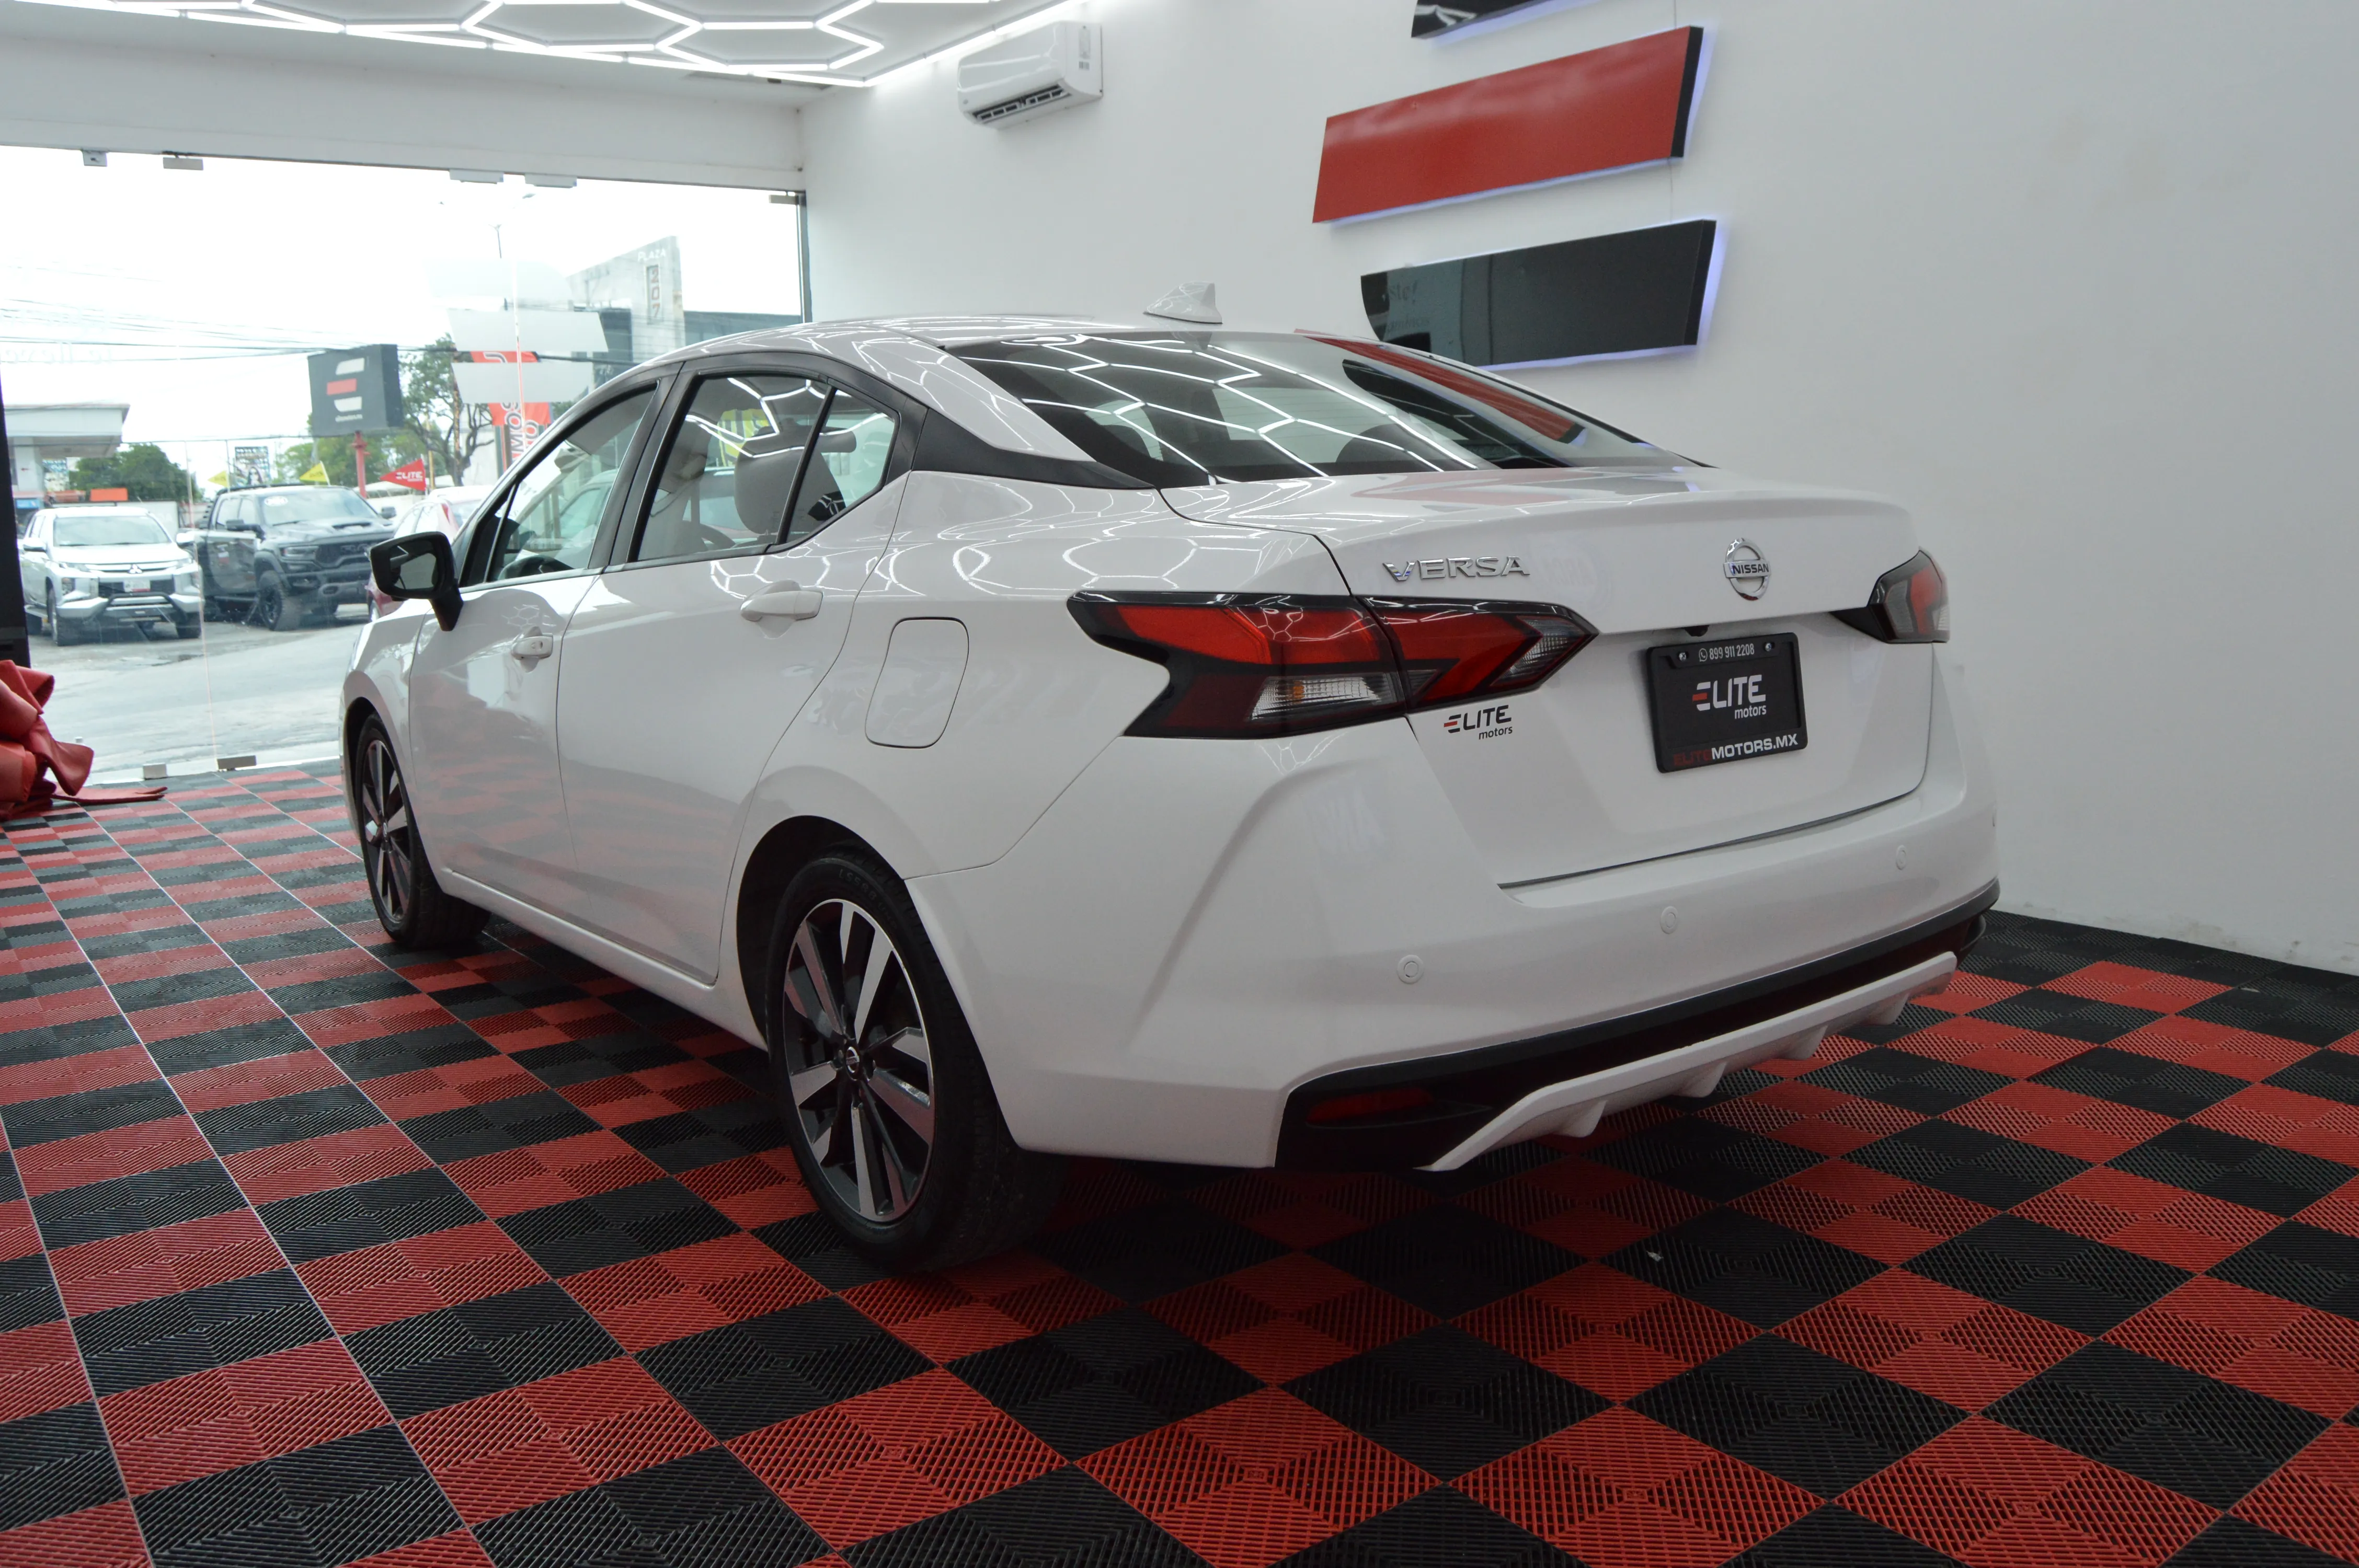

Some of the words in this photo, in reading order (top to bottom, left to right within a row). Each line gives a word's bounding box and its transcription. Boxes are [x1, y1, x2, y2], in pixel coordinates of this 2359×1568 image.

[638, 249, 666, 262] PLAZA
[651, 268, 660, 318] 207
[1382, 556, 1531, 582] VERSA
[1732, 563, 1769, 575] NISSAN
[1709, 647, 1724, 661] 899
[1725, 645, 1735, 658] 911
[1736, 643, 1755, 656] 2208
[1692, 674, 1766, 711] ELITE
[1444, 705, 1511, 734] ELITE
[1735, 705, 1767, 720] motors
[1479, 727, 1513, 740] motors
